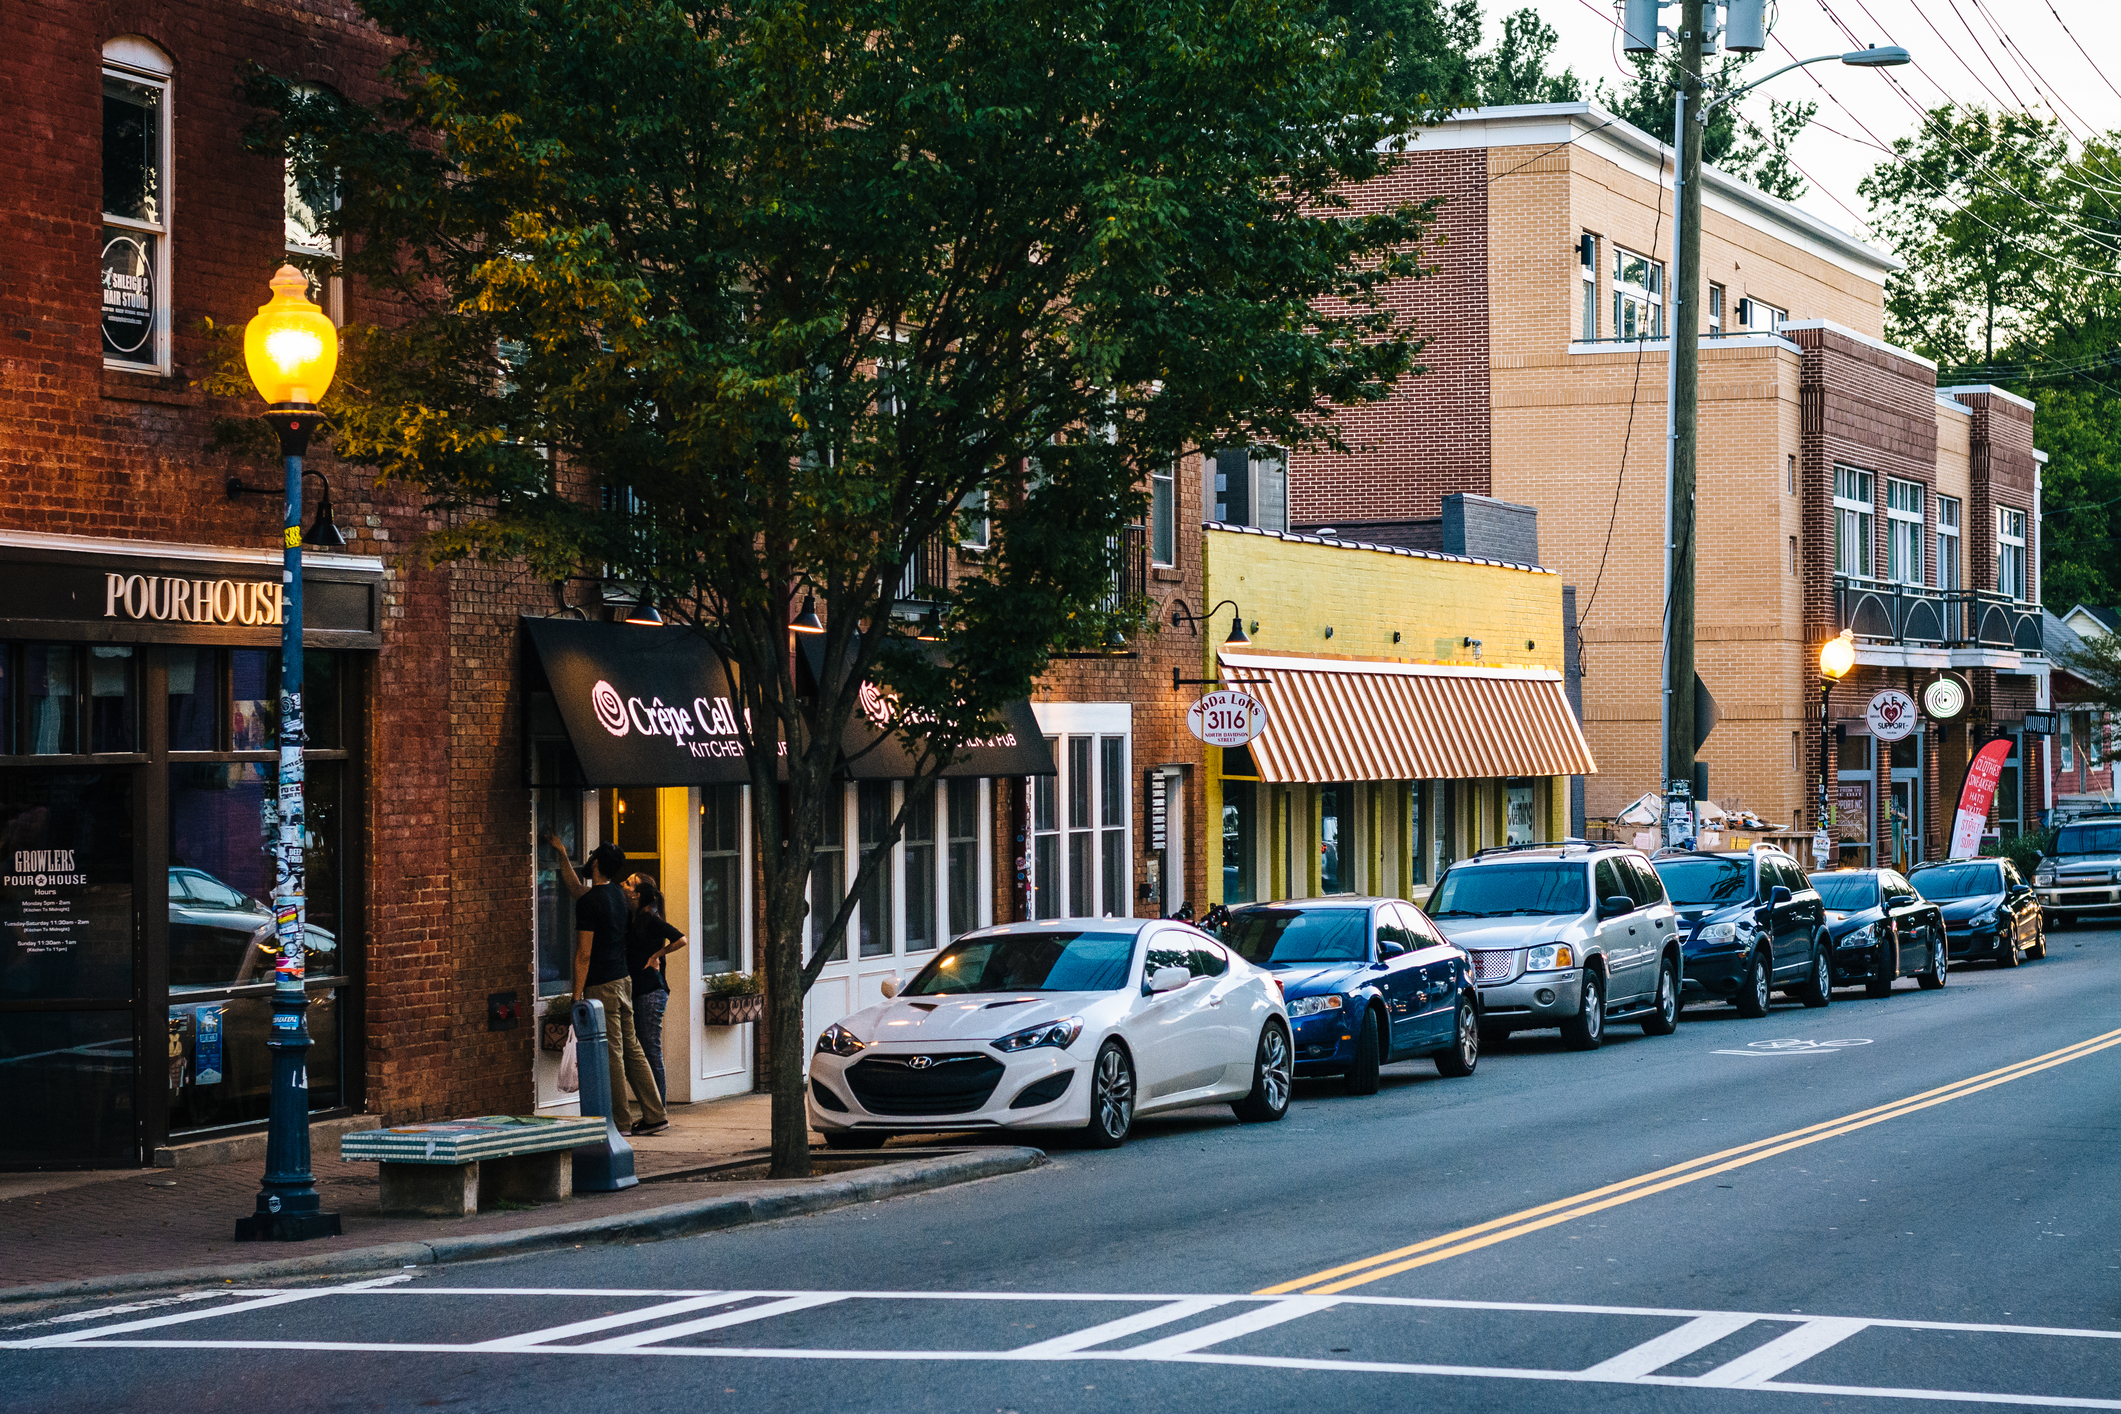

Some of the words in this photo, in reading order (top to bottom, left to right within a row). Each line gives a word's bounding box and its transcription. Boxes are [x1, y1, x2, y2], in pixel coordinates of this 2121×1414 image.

[104, 289, 121, 306] HAIR
[122, 292, 149, 310] STUDIO
[1192, 696, 1226, 717] NoDa
[1230, 694, 1260, 716] Lofts
[628, 697, 694, 746] Crêpe
[694, 697, 752, 736] Cell
[1208, 710, 1245, 729] 3116
[1878, 722, 1906, 730] SUPPORT
[2026, 716, 2049, 733] VIVIAN
[2050, 716, 2056, 733] B
[1975, 758, 2001, 777] CLOTHES
[1968, 774, 1996, 792] SNEAKERS
[1969, 792, 1984, 804] HATS
[1961, 819, 1980, 834] STREET
[15, 850, 75, 872] GROWLERS
[4, 876, 34, 886] POUR
[48, 874, 87, 885] HOUSE
